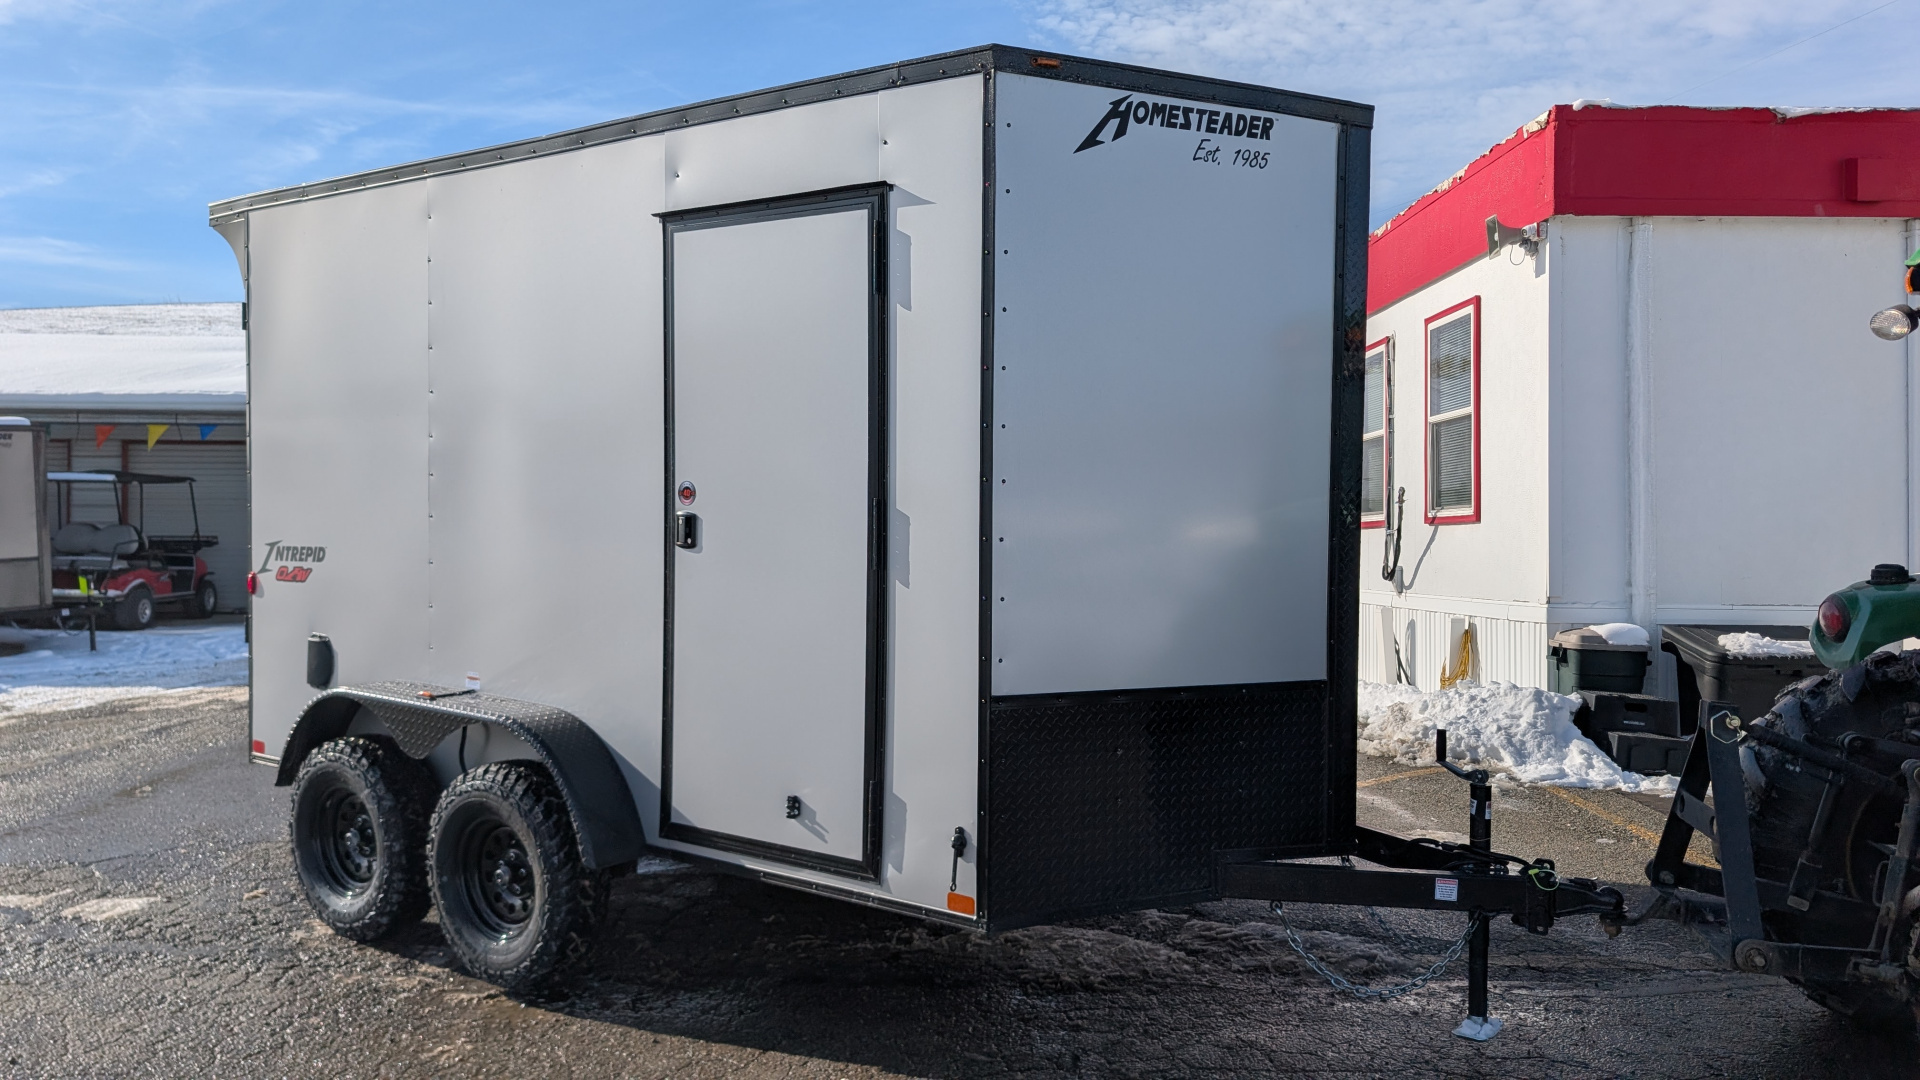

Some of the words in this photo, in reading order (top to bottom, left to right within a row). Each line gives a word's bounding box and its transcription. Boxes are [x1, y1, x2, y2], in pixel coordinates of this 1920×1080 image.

[1073, 94, 1274, 154] HOMESTEADER
[1192, 138, 1221, 165] Est.
[1232, 149, 1270, 169] 1985
[257, 540, 326, 574] INTREPID
